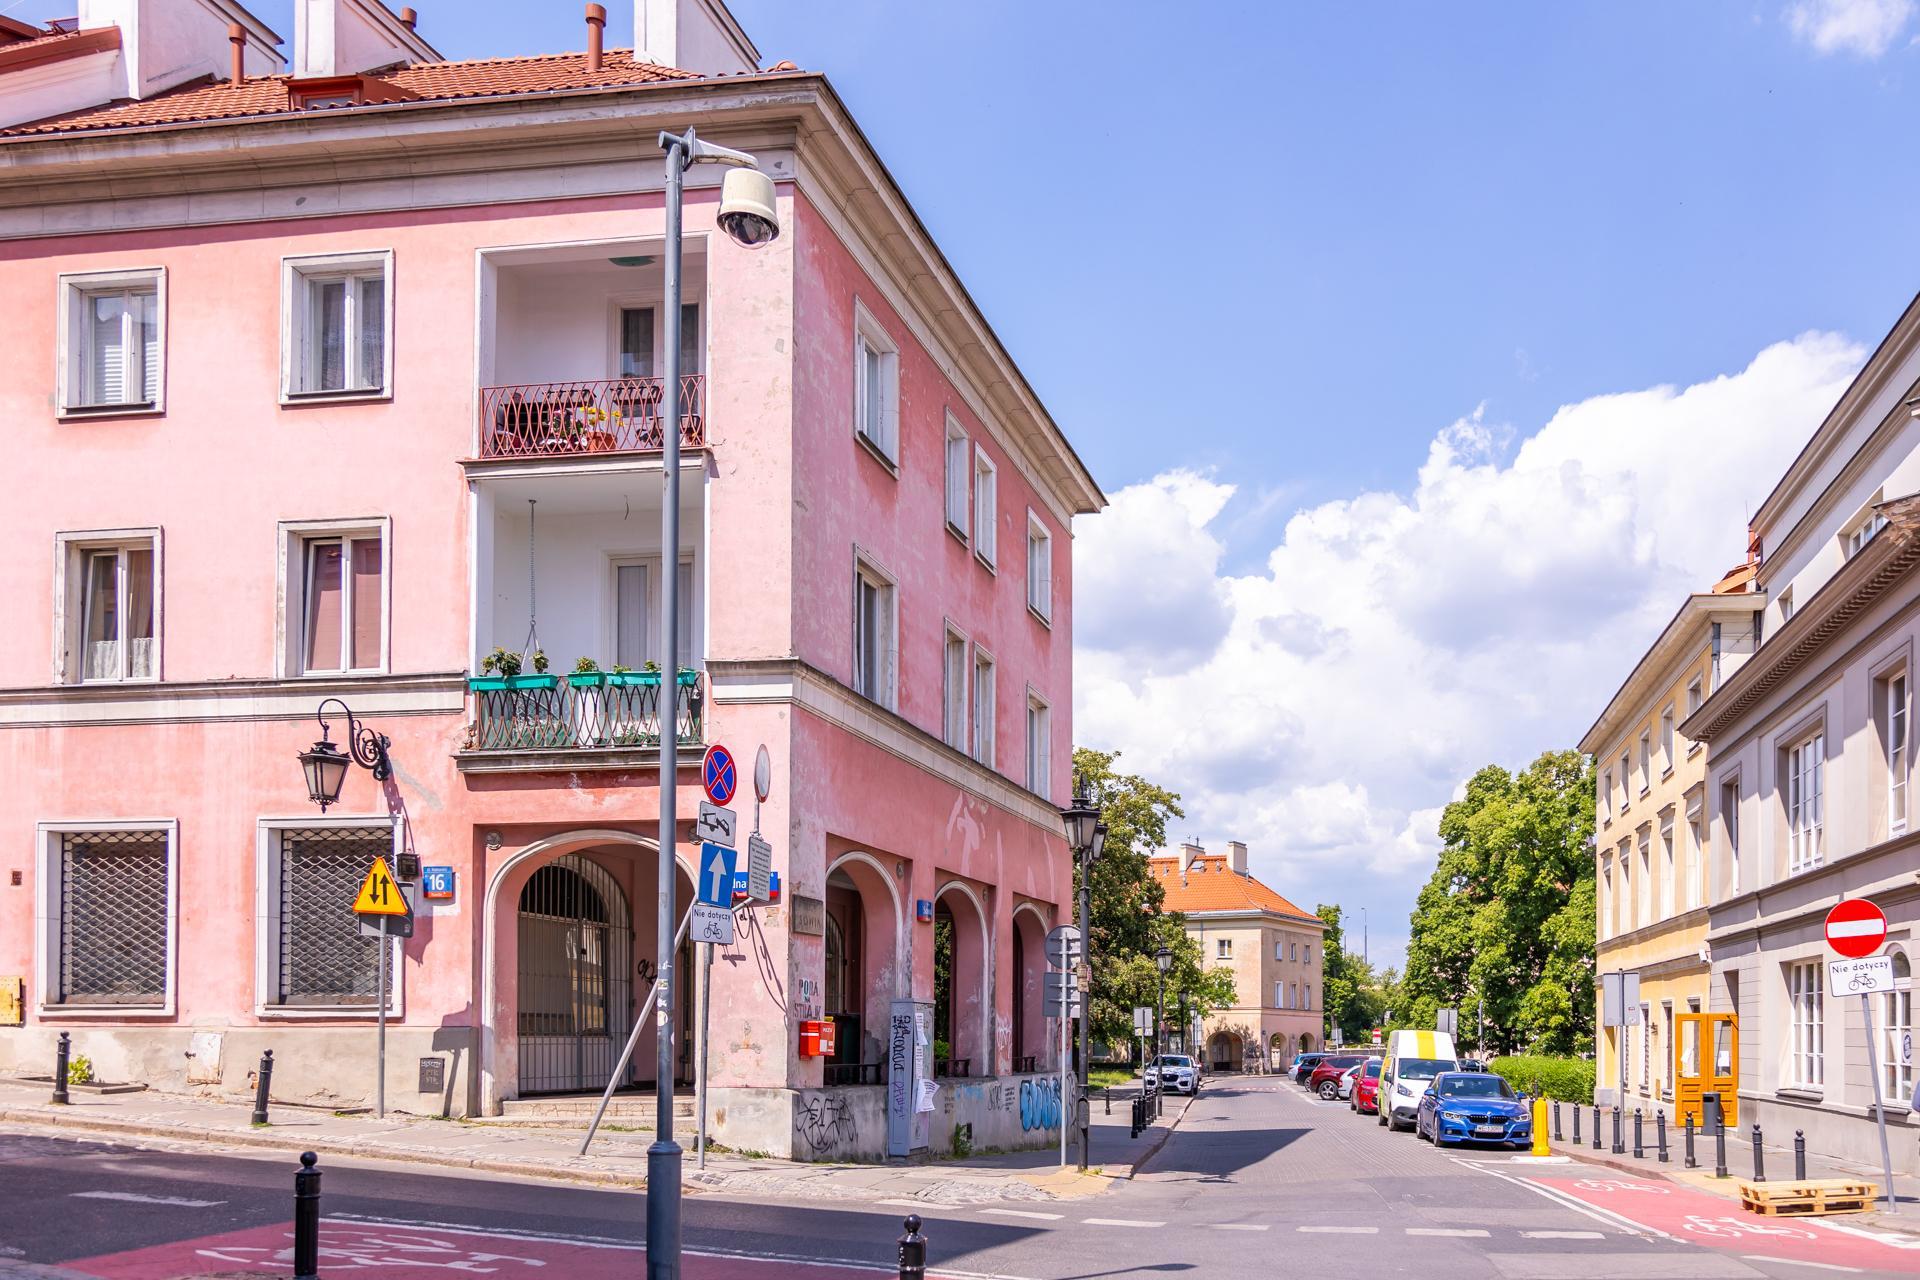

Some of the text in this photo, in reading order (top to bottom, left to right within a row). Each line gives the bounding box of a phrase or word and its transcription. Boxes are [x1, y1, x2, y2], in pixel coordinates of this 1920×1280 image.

[429, 873, 445, 891] 16
[693, 909, 731, 922] Nie dotyczy
[1832, 960, 1889, 974] Nie dotyczy
